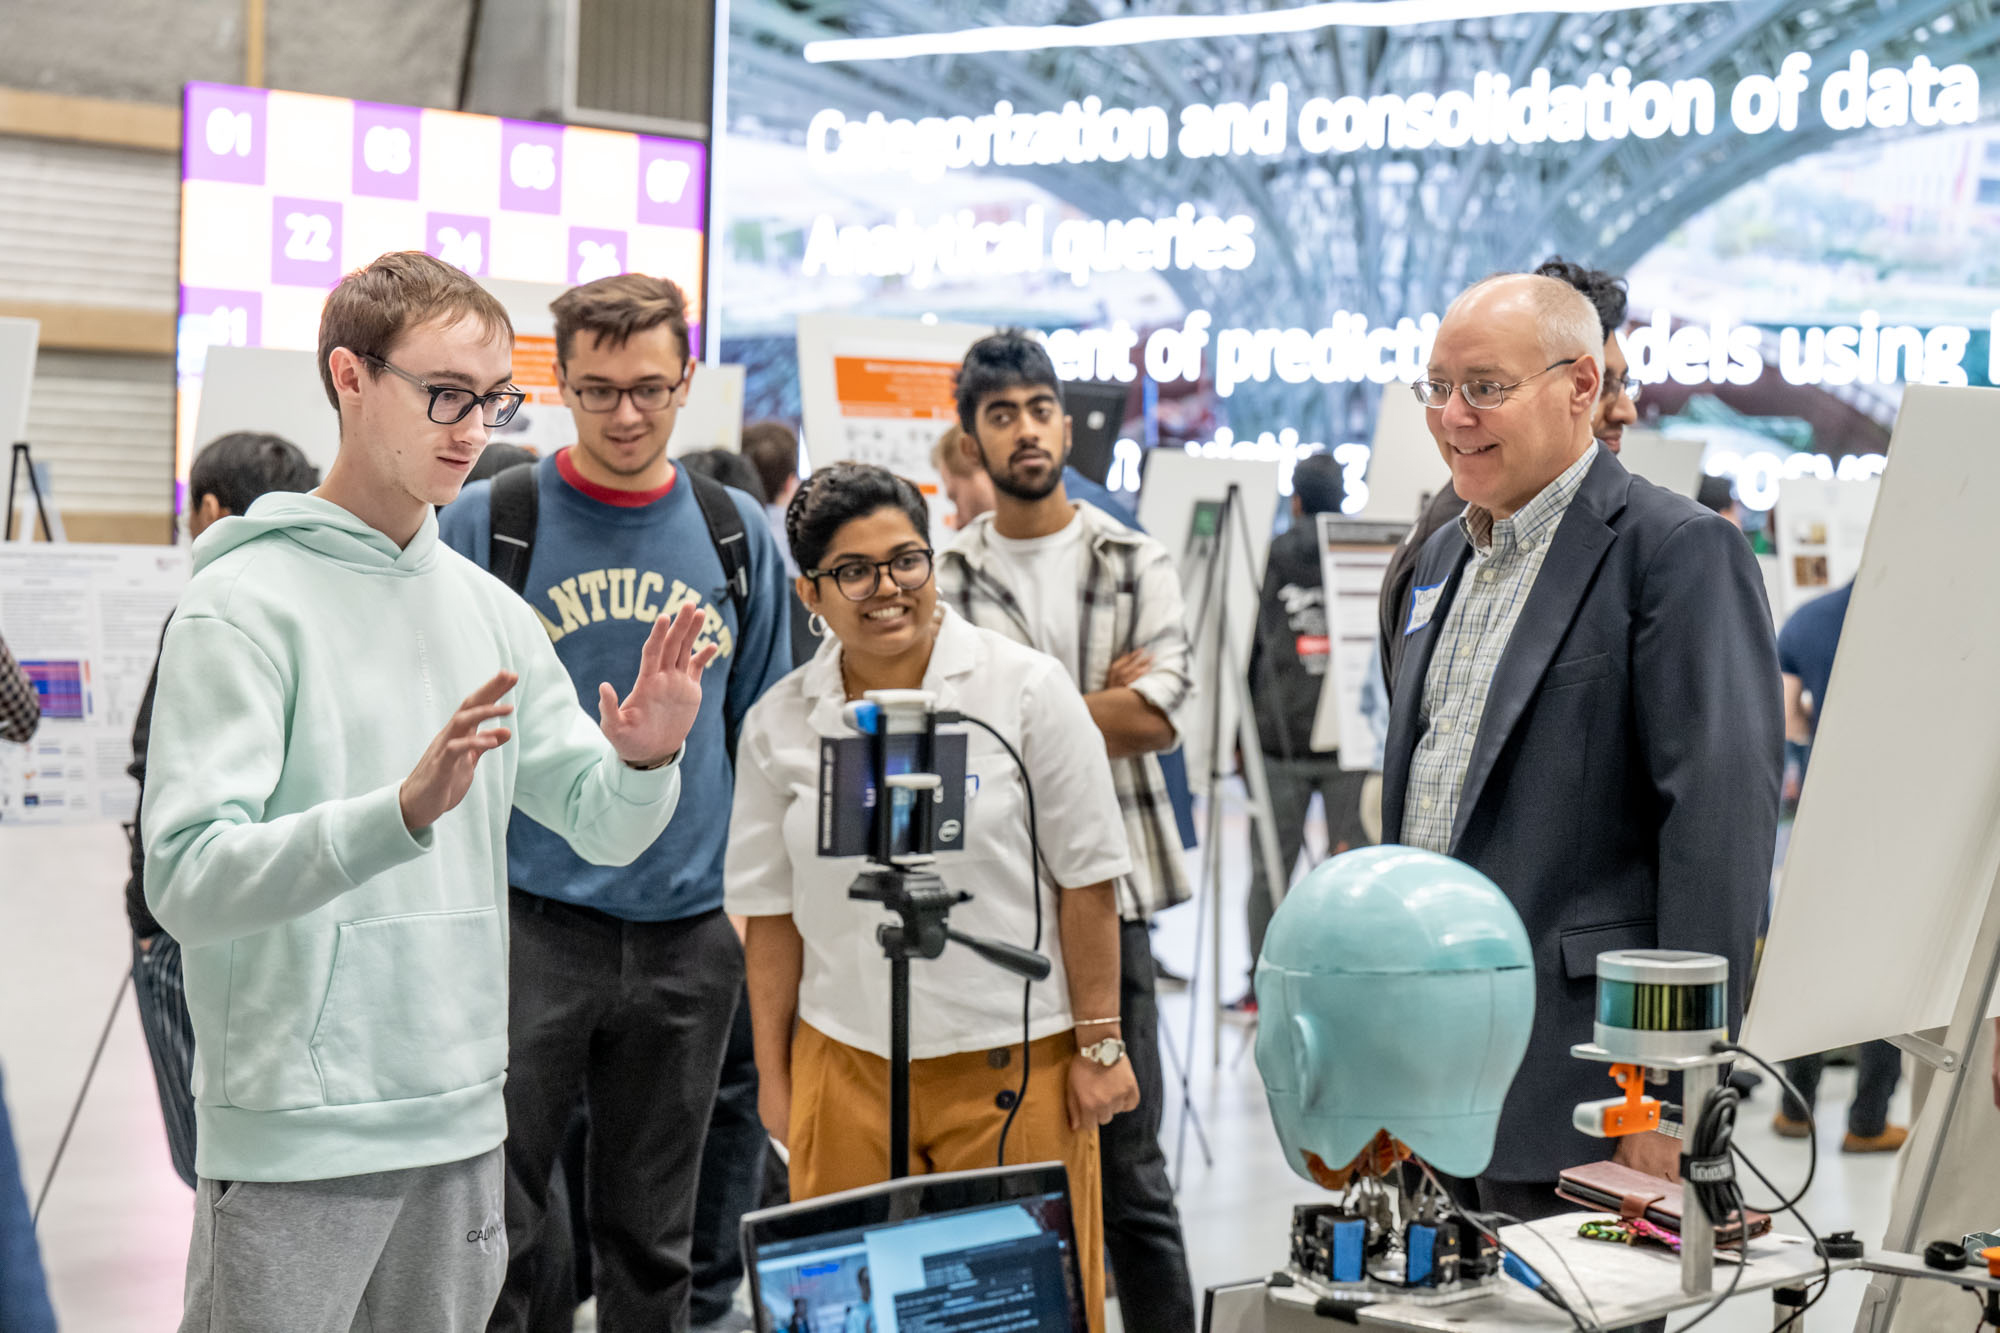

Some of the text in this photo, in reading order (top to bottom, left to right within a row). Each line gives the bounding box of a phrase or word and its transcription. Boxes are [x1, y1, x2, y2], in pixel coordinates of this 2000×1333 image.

[207, 108, 251, 156] 01
[808, 51, 1978, 180] Categorization and consolidation of data
[647, 159, 690, 202] 07
[286, 213, 332, 261] 22
[804, 204, 1254, 288] Analytical queries
[1039, 321, 1137, 380] ent
[1146, 311, 1210, 381] of
[1217, 311, 1439, 396] predicti
[1617, 310, 1762, 383] dels
[1782, 310, 1969, 385] using
